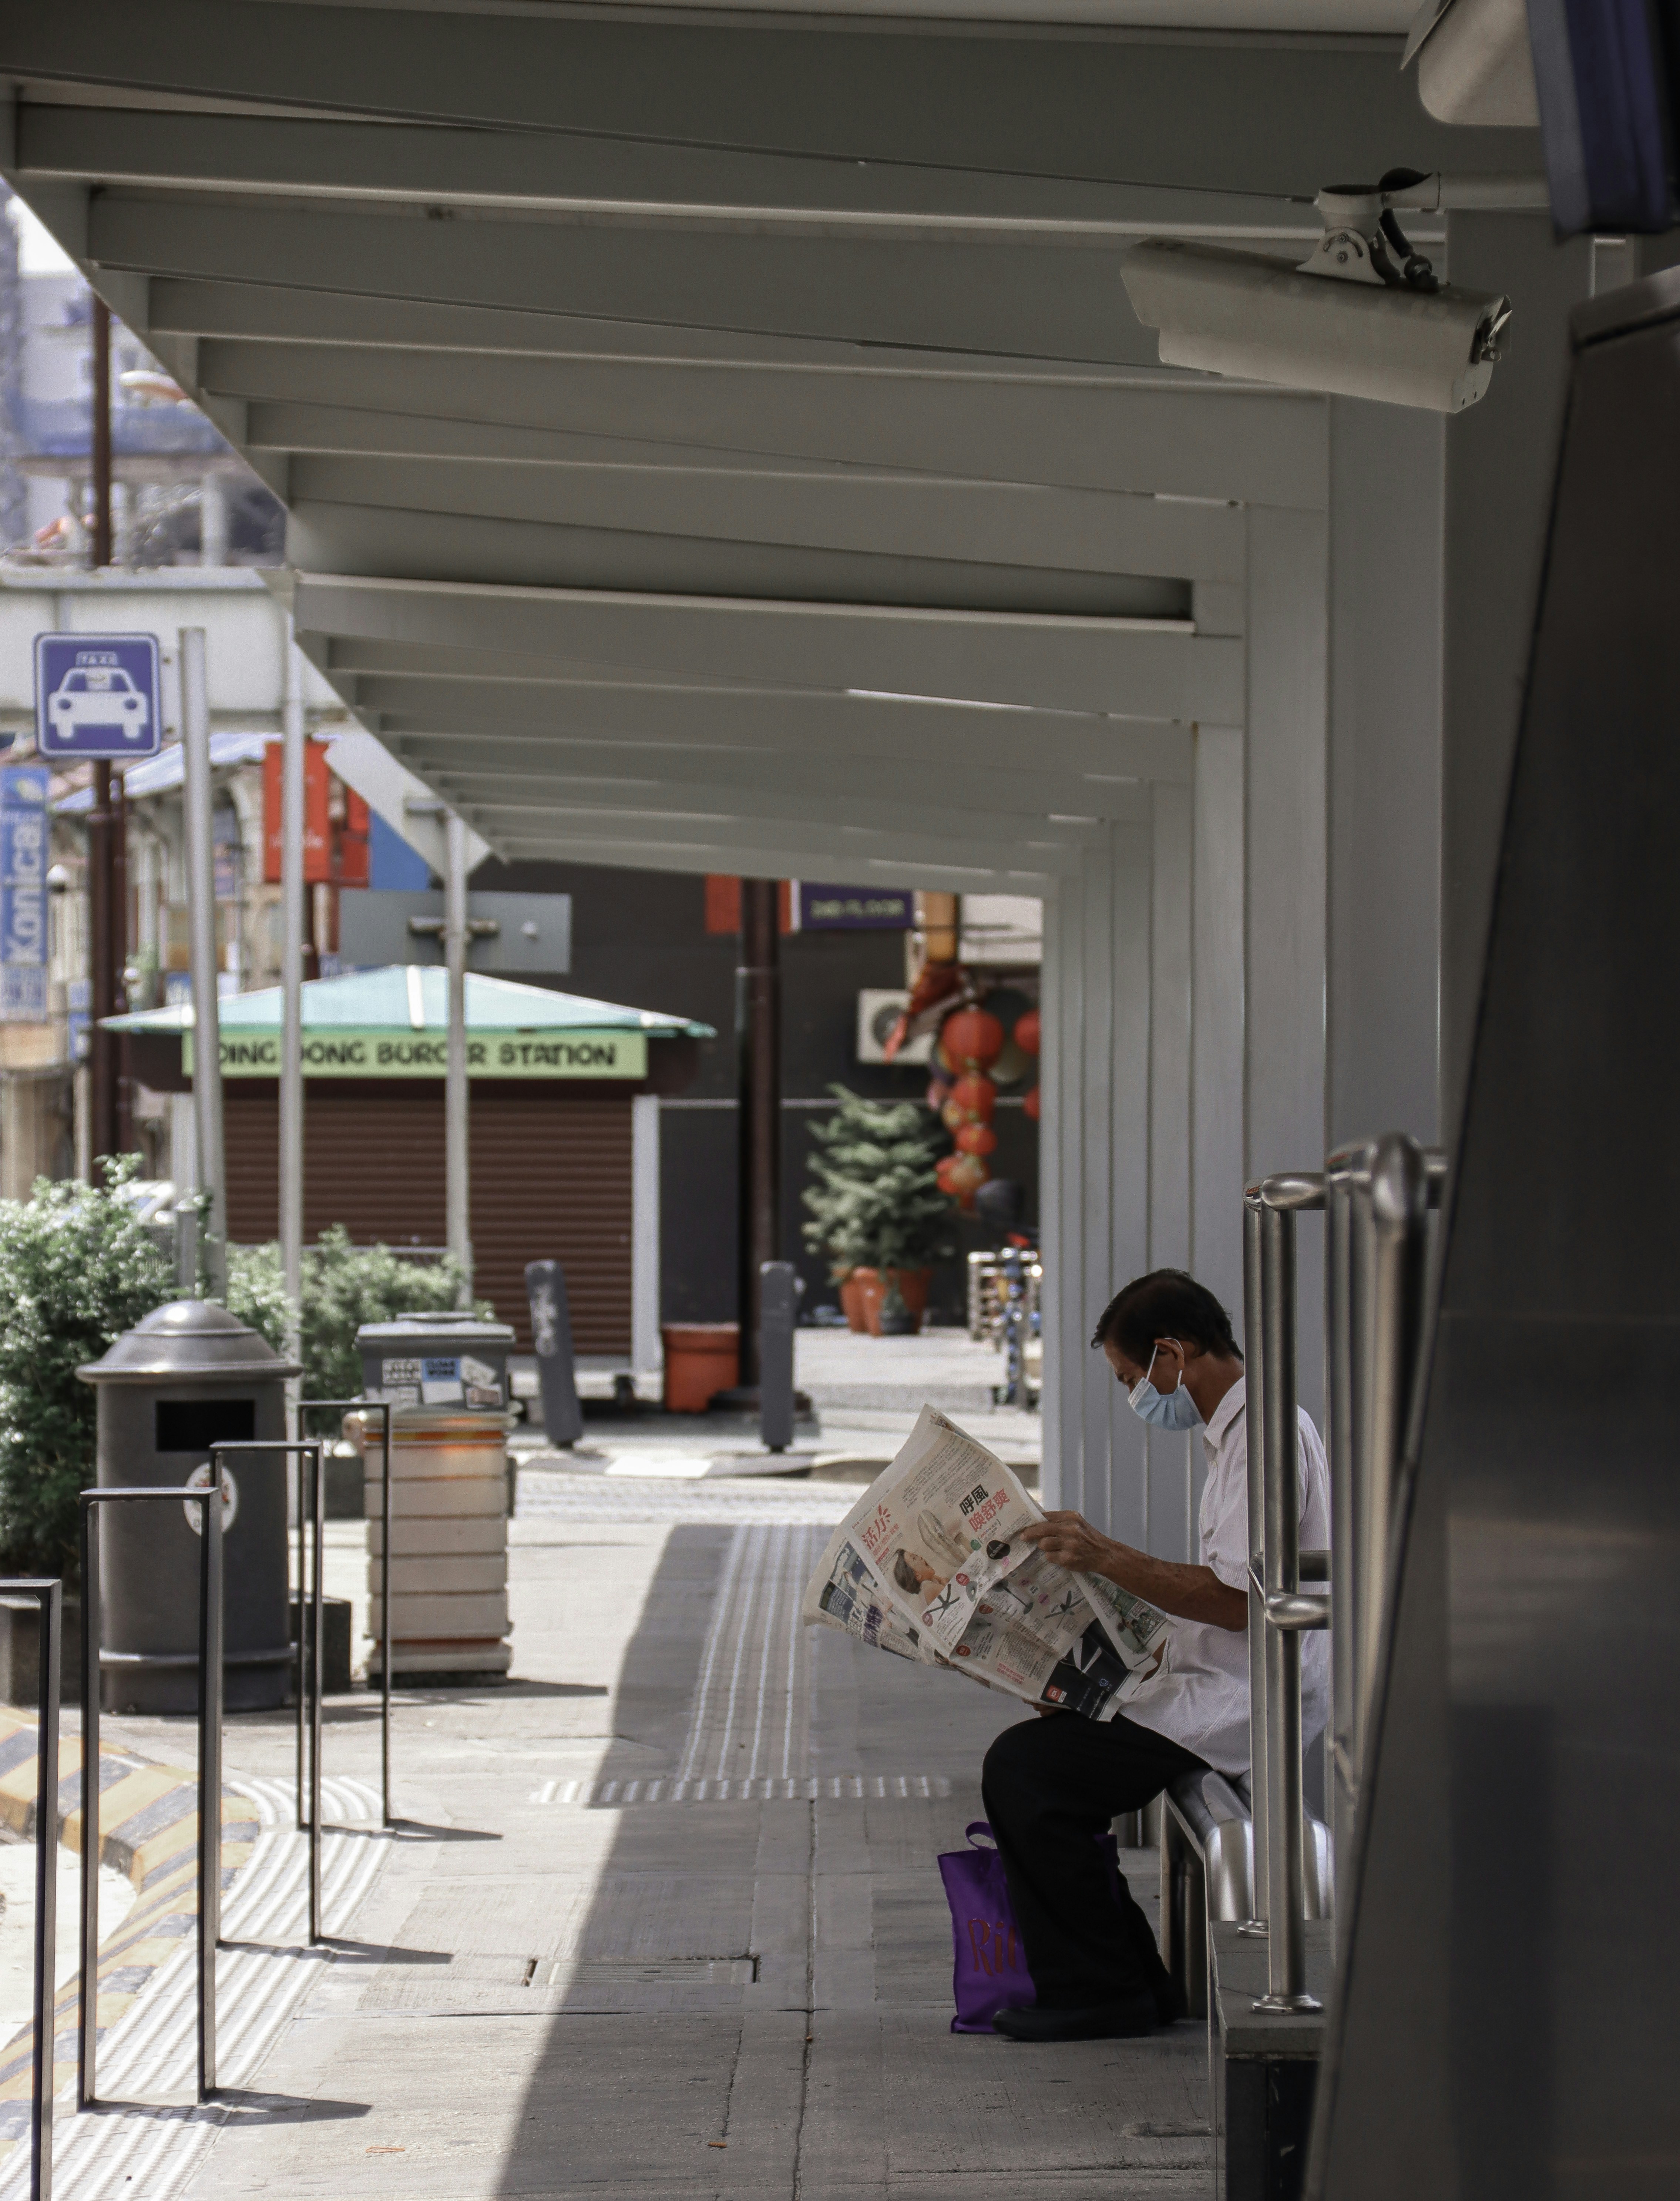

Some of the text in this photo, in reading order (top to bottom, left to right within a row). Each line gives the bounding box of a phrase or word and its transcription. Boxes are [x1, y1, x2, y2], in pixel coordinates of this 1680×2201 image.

[78, 654, 117, 665] TAXI
[300, 1040, 365, 1064] ONG
[377, 1041, 485, 1064] BURGR
[498, 1042, 616, 1067] STATION
[960, 1484, 988, 1516] 呼風
[968, 1488, 1010, 1532] 喚舒爽
[861, 1517, 887, 1550] 活力
